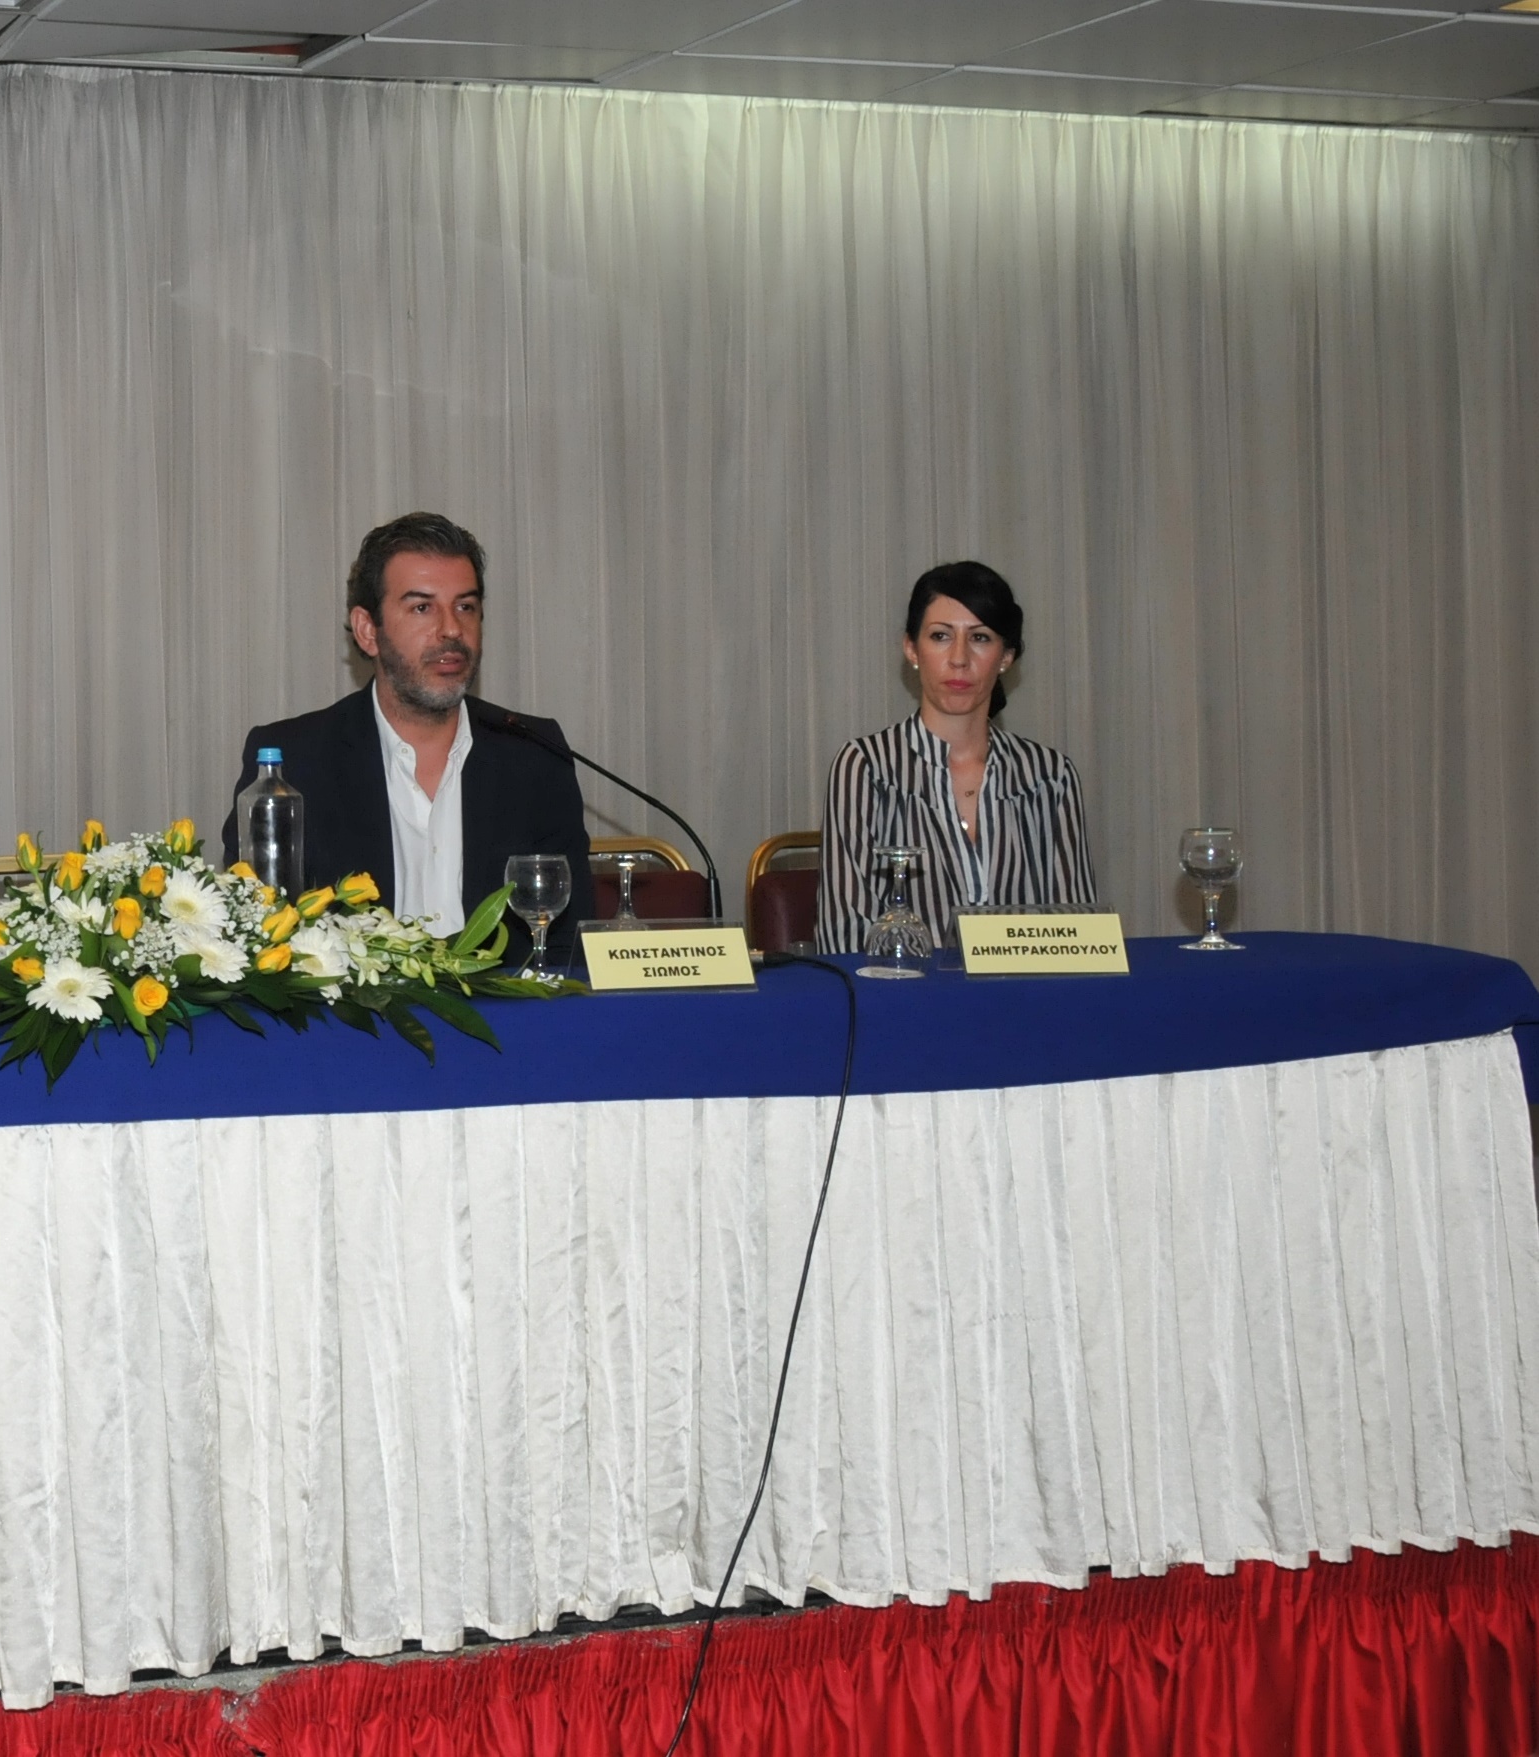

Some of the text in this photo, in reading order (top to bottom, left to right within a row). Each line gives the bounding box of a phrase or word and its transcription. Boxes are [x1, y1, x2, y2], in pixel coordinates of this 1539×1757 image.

[1006, 927, 1078, 939] ΒΑΣΙΛΙΚΗ
[608, 945, 727, 960] ΚΩΝΣΤΑΝΤΙΝΟΣ
[971, 944, 1118, 956] ΔΗΜΗΤΡΑΚΟΠΟΥΛΟΥ
[642, 965, 701, 978] ΣΙΩΜΟΣ
